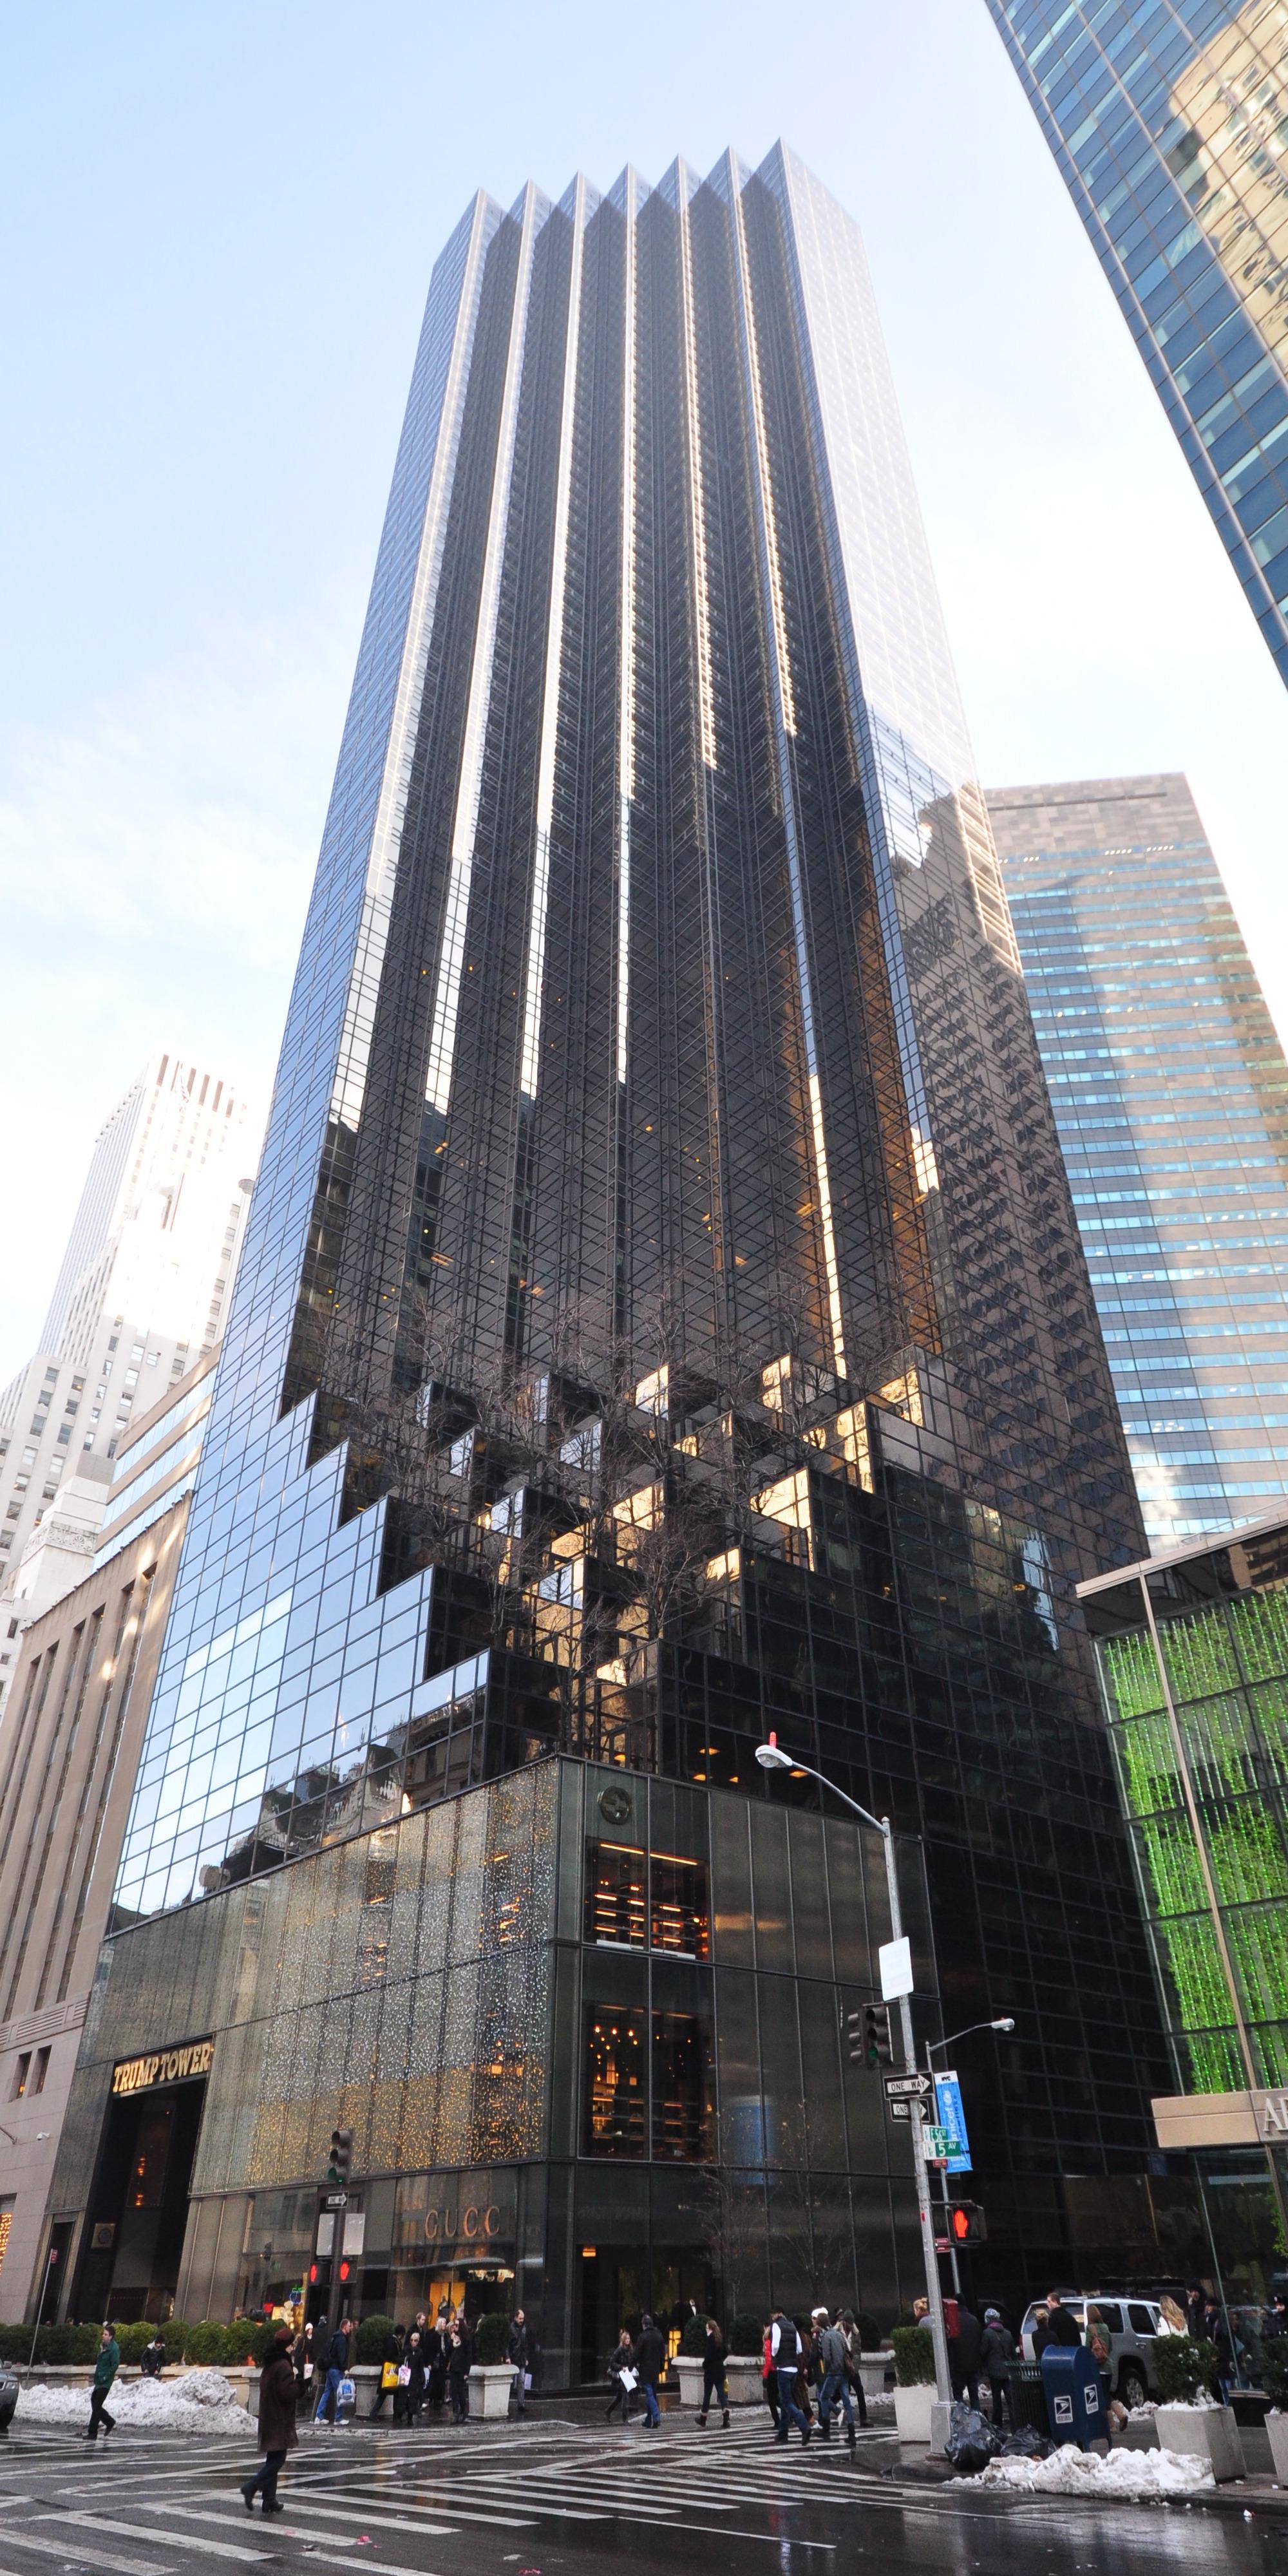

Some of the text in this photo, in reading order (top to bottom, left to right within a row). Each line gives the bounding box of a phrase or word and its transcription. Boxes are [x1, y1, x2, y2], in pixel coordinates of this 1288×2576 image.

[113, 2043, 211, 2093] TRUMP TOWER
[891, 2080, 925, 2092] ONE WAY
[896, 2105, 908, 2114] ONE
[938, 2143, 946, 2157] 5
